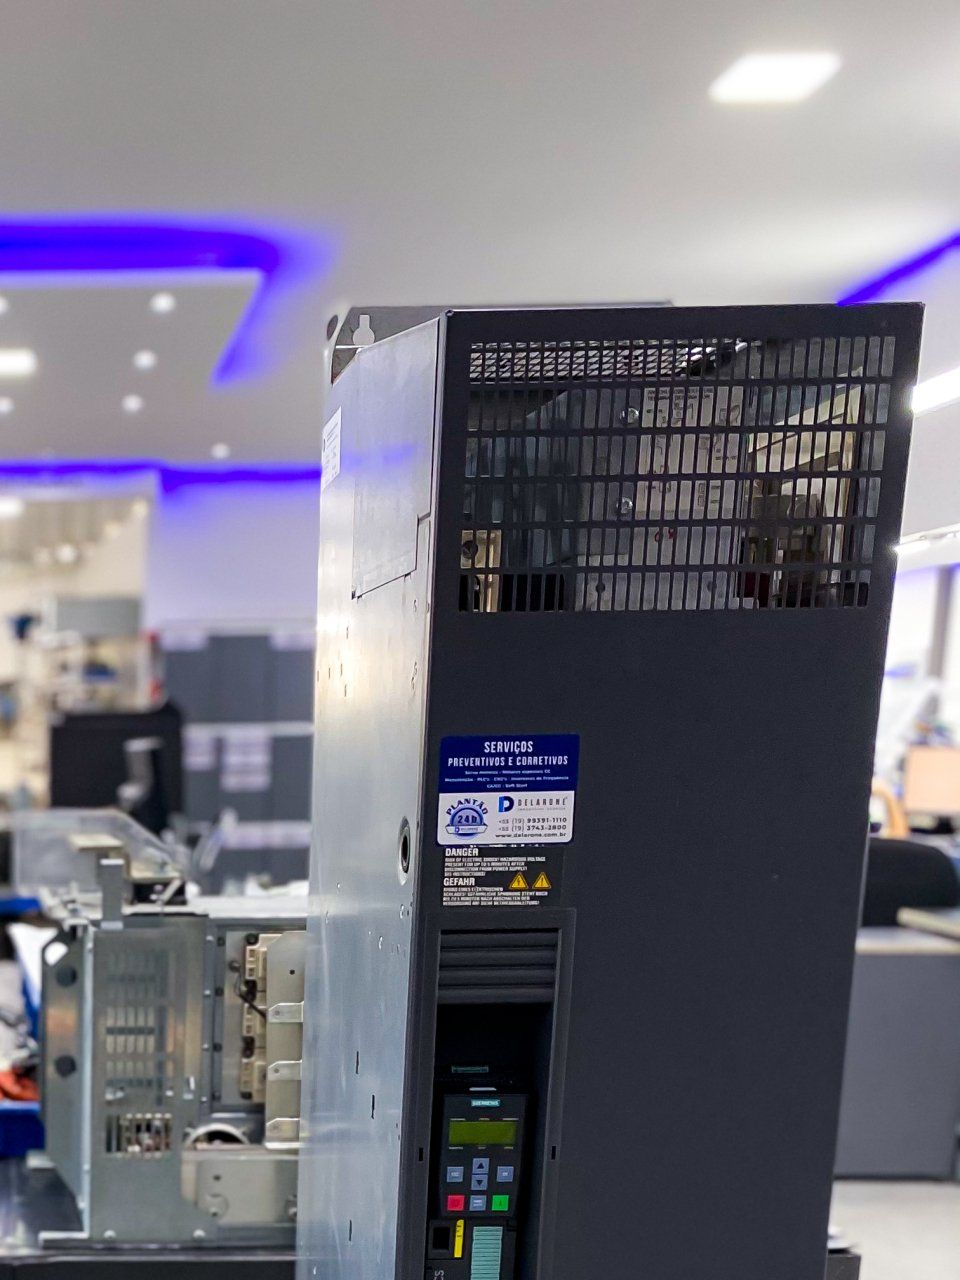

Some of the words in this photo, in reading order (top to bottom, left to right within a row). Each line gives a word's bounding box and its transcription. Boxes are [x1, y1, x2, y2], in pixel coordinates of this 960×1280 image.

[484, 741, 533, 754] SERVIÇOS
[448, 757, 505, 767] PREVENTIVOS
[508, 757, 513, 766] E
[516, 755, 568, 766] CORRETIVOS
[446, 798, 488, 815] PLANTÃO
[517, 798, 567, 807] DELARONE
[445, 847, 479, 857] DANGER
[443, 877, 476, 886] GEFAHR
